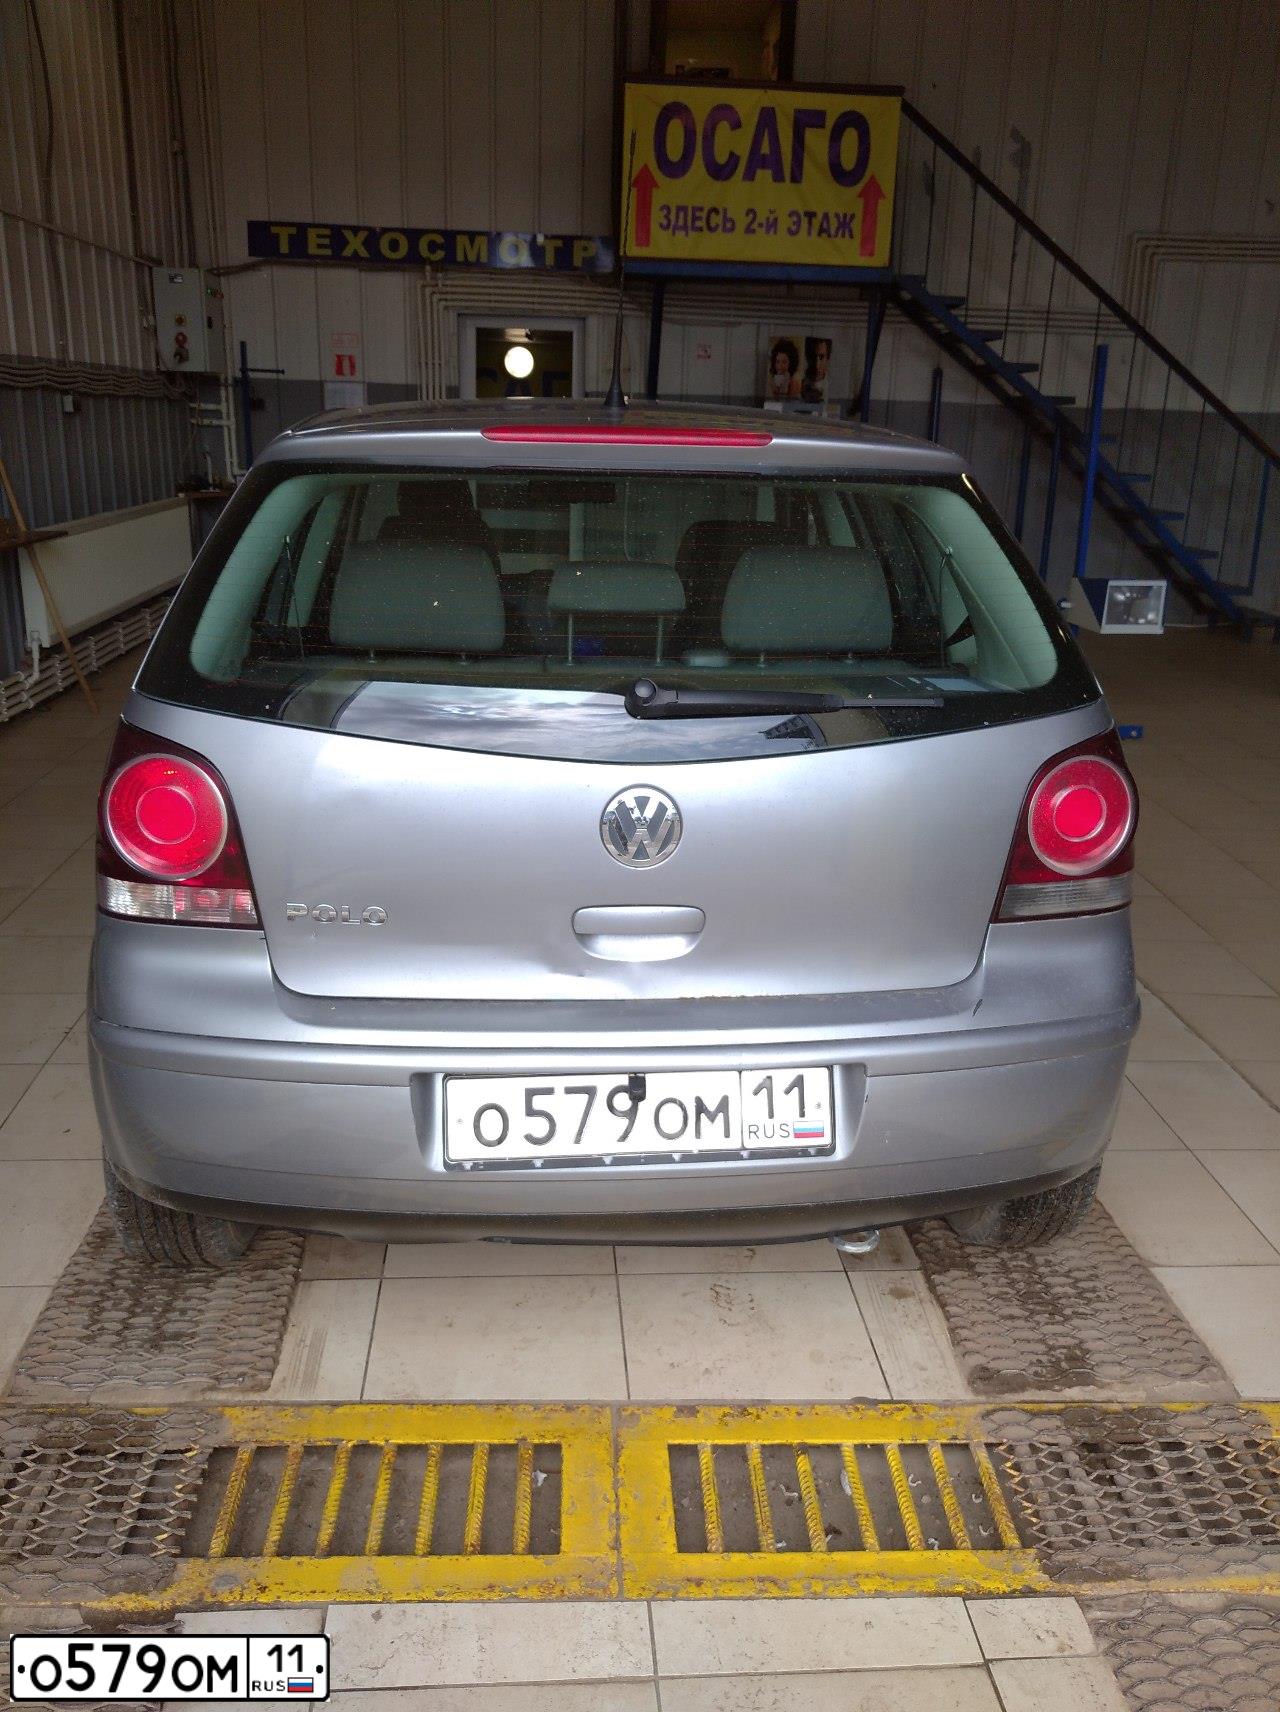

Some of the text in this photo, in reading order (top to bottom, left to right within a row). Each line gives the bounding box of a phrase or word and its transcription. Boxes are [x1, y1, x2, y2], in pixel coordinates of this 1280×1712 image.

[654, 101, 871, 188] ОСАГО
[659, 204, 856, 240] ЗДЕСЬ 2-й ЭТАЖ
[270, 225, 598, 269] ТЕХОСМОТР
[285, 902, 389, 926] POLO
[752, 1075, 806, 1120] 11
[748, 1122, 790, 1140] RUS
